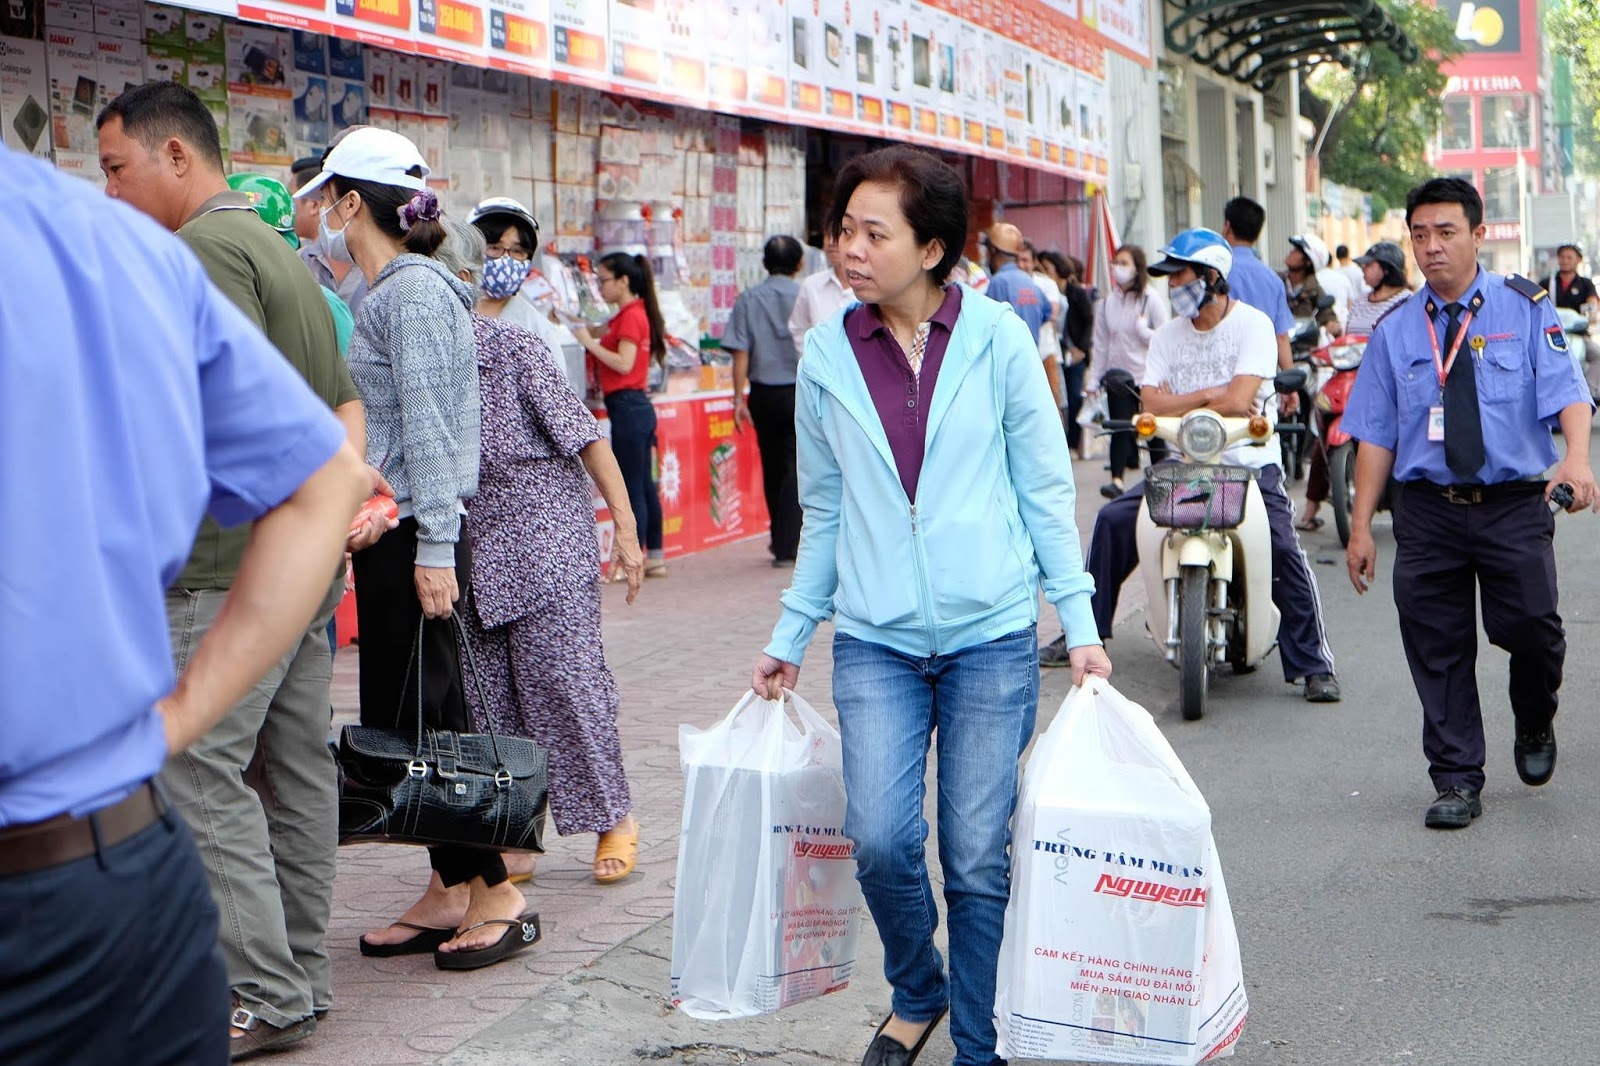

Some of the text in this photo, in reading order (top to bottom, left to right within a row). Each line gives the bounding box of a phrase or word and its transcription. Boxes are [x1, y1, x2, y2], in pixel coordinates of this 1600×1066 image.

[1447, 75, 1522, 92] OTTERIA
[794, 840, 853, 859] NguyenK
[1032, 840, 1206, 878] TRUNG TÂM MUA S
[1034, 947, 1058, 958] CAM
[1062, 951, 1084, 962] KẾT
[1088, 956, 1120, 968] HÀNG
[1123, 961, 1157, 974] CHÍNH
[1161, 967, 1192, 978] HÃNG
[1080, 969, 1196, 992] MUA SẮM ƯU ĐÃI MỖI
[1070, 981, 1098, 993] MIỄN
[1102, 987, 1120, 997] PHÍ
[1123, 990, 1150, 1001] GIAO
[1154, 995, 1185, 1006] NHẬN
